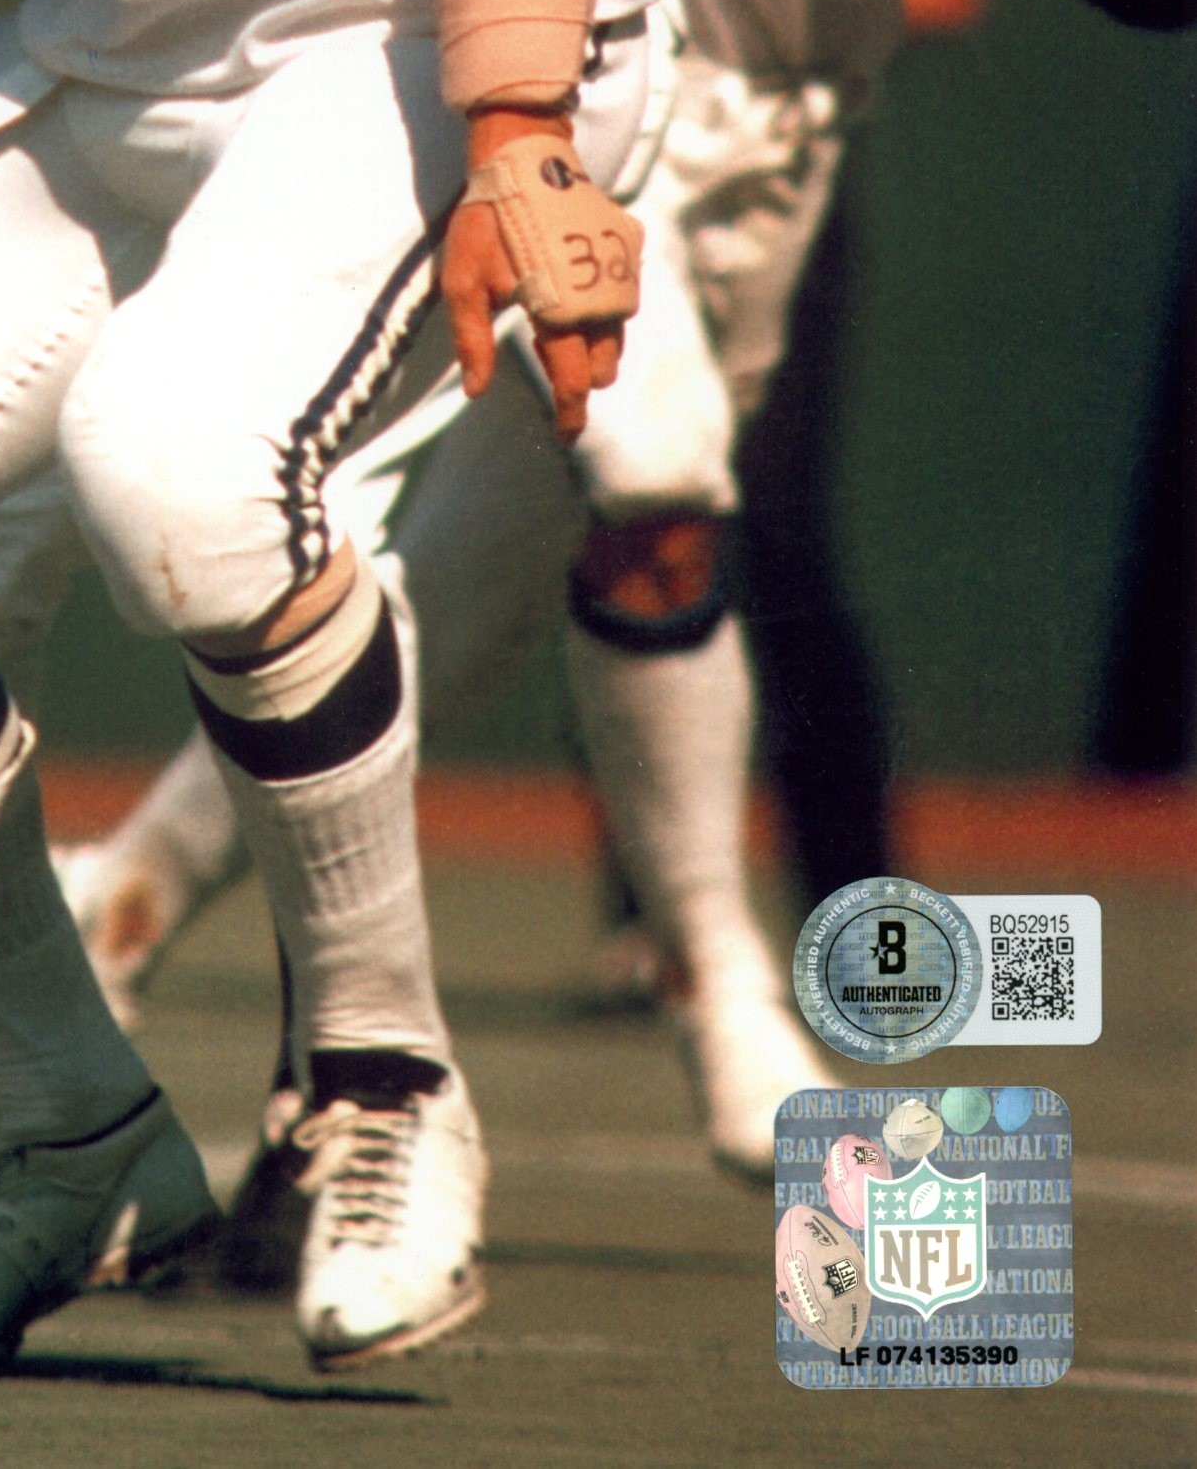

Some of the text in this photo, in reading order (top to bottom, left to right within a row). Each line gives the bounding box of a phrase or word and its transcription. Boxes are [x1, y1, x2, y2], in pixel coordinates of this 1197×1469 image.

[563, 230, 637, 291] 32
[813, 888, 871, 945] AUTHENTIC
[909, 888, 960, 930] BECKETT
[990, 914, 1070, 934] BQ52915
[808, 946, 826, 1010] VERIFIED
[841, 985, 942, 1002] AUTHENTICATED
[859, 1006, 924, 1015] AUTOGRAPH
[910, 994, 969, 1051] AUTHENTIC
[819, 1010, 871, 1051] BECKETT
[935, 1134, 1047, 1162] NATIONAL
[838, 1260, 858, 1291] NFL
[880, 1229, 973, 1296] NFL
[870, 1313, 1074, 1341] FOOTBALL LEAGUE
[840, 1345, 1018, 1366] LF 074135390
